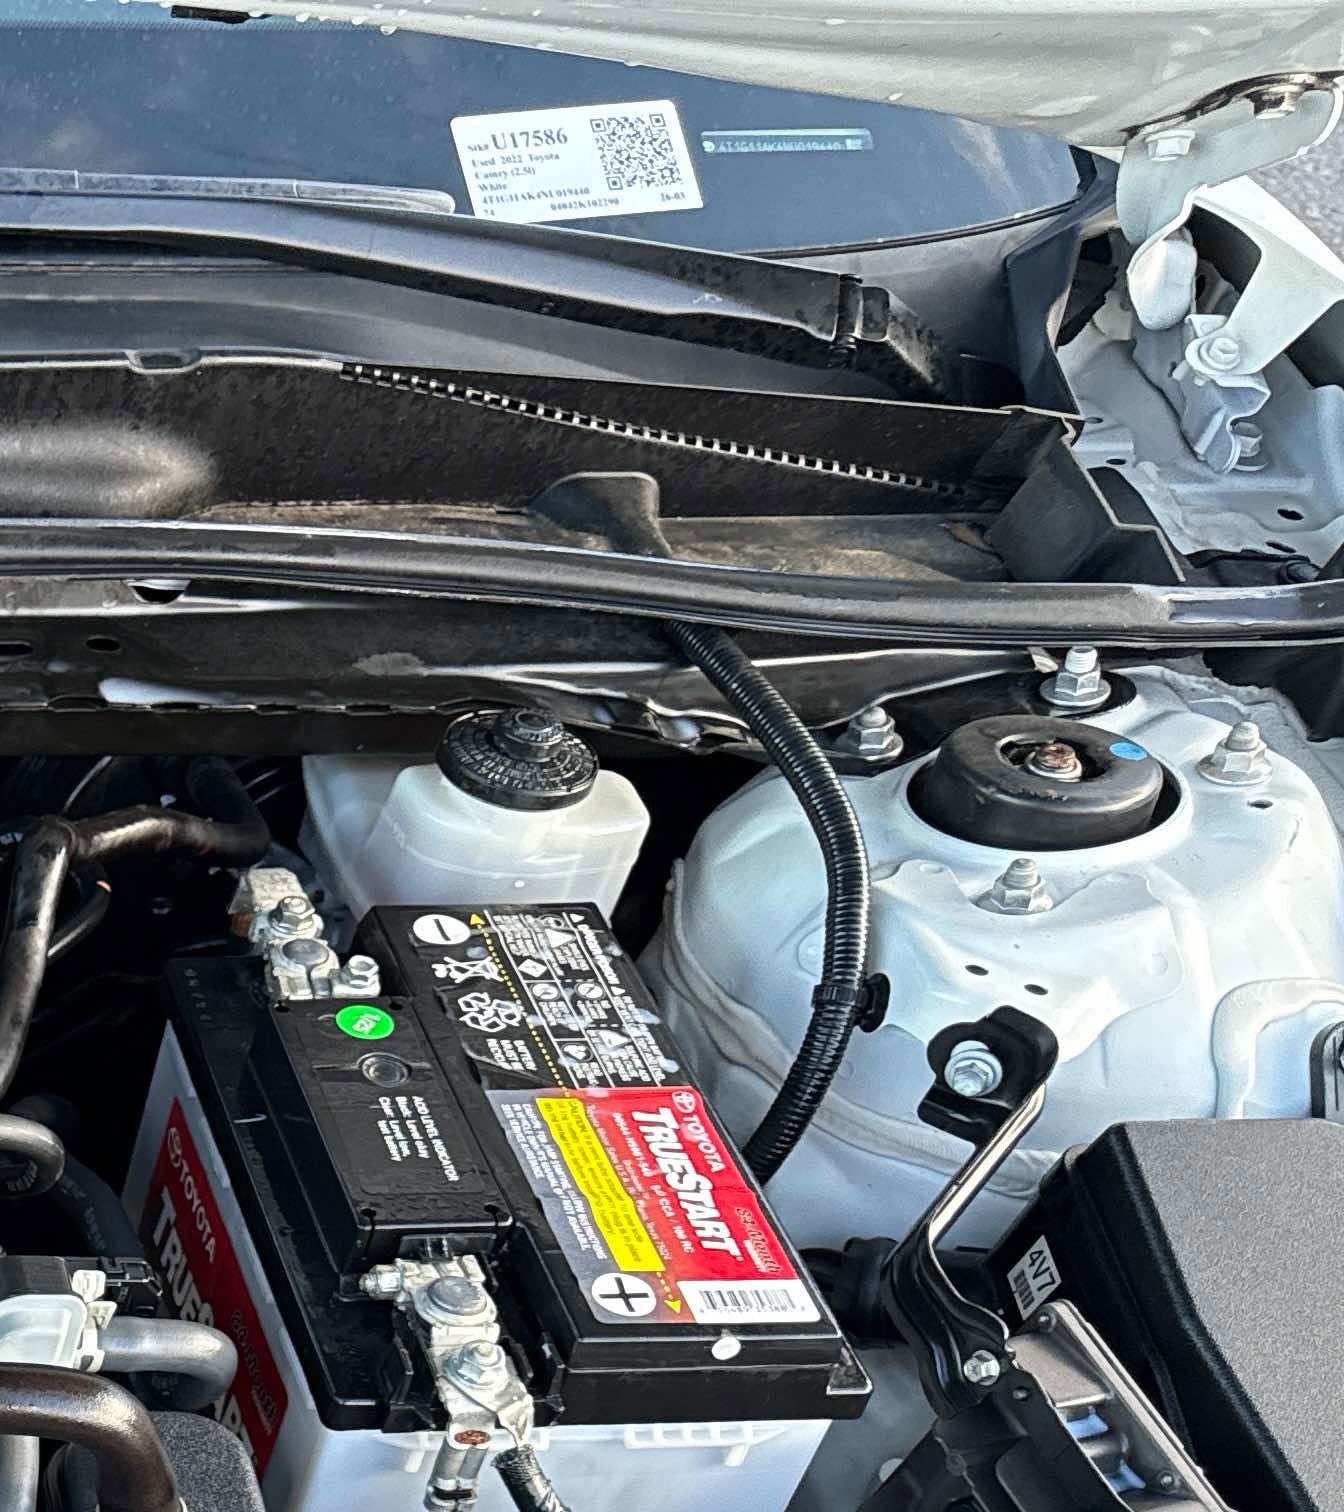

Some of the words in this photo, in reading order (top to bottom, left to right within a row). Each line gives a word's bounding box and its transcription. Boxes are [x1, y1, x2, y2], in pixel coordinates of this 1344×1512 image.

[491, 128, 568, 150] U17586
[513, 1039, 538, 1071] BATTERY
[412, 1096, 430, 1114] ACID
[405, 1120, 424, 1140] Level
[420, 1115, 440, 1139] LEVEL
[683, 1114, 726, 1173] TOYOTA
[431, 1138, 459, 1181] INDICATOR
[176, 1158, 216, 1264] TOYOTA
[659, 1197, 675, 1218] CCA
[1028, 1249, 1057, 1292] 4V7
